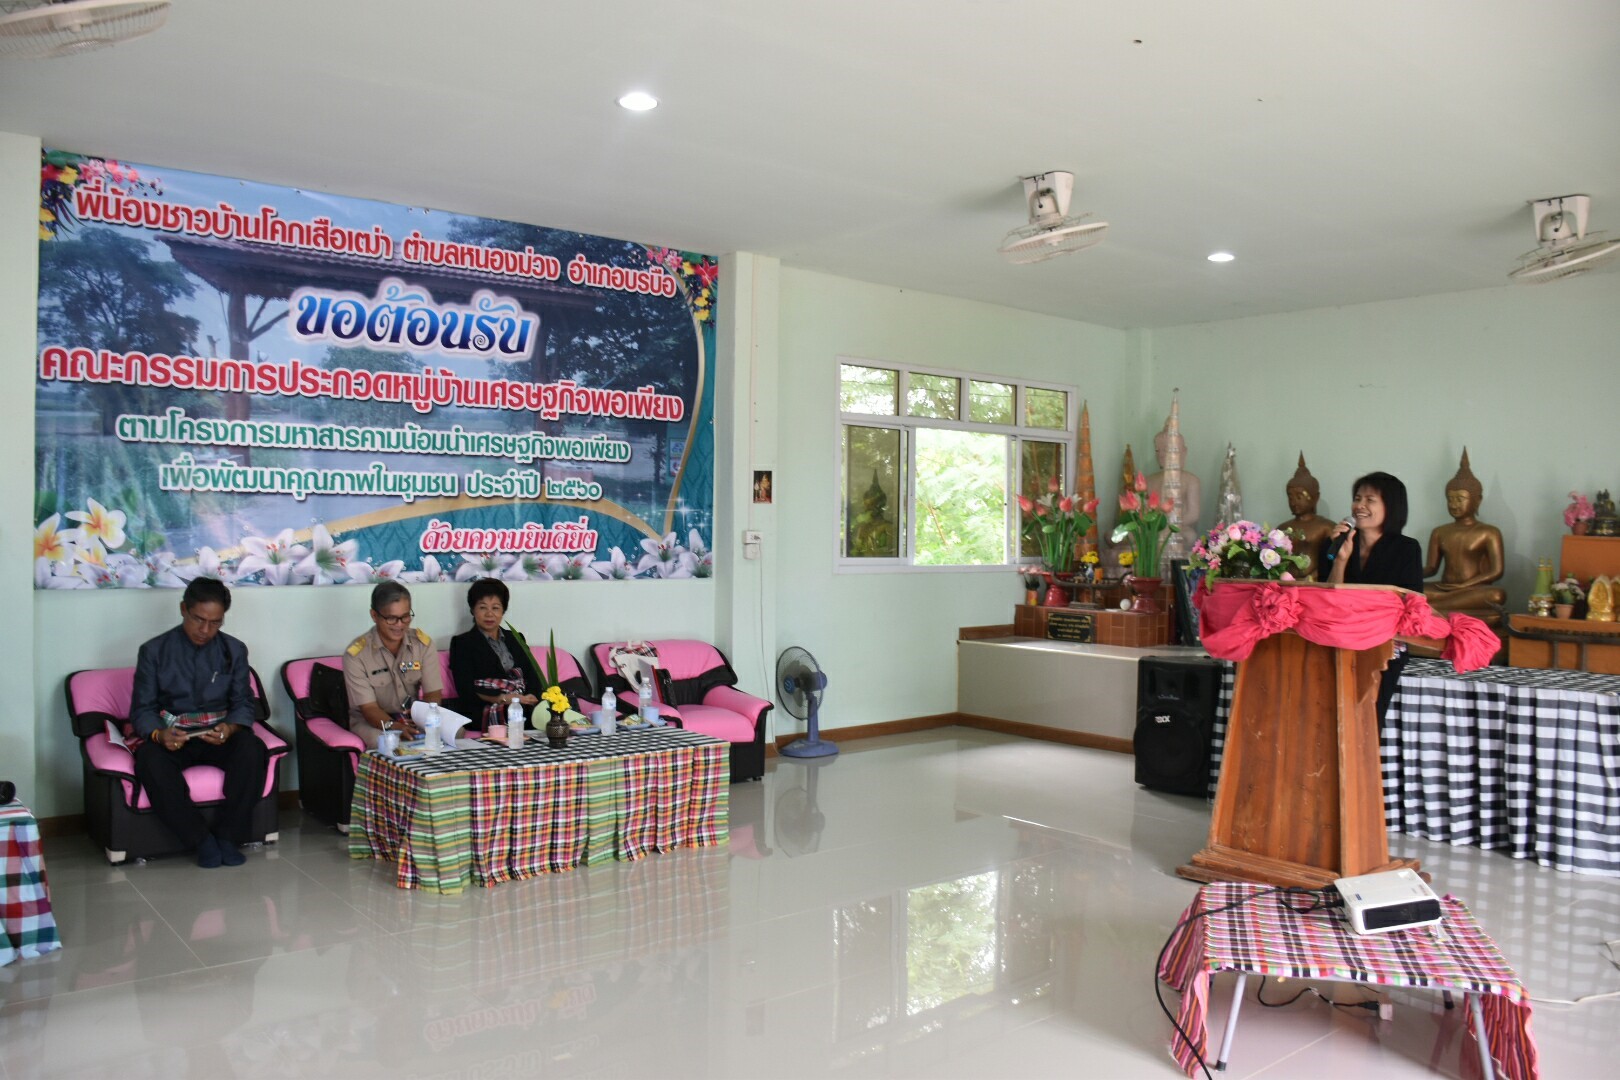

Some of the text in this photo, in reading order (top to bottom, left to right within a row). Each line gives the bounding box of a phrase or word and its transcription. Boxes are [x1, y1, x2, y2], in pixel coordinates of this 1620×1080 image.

[404, 232, 559, 280] ตำบลหนองม่วง
[569, 255, 675, 296] อำเภอบรบือ
[296, 285, 532, 354] ขอต้อนรับ
[42, 347, 683, 420] คณะกรรมการประกวดหมู่บ้านเศรษฐกิจพอเพียง
[118, 410, 630, 461] ตามโครงการมหาสารคามน้อมนำเศรษฐกิจพอเพียง
[161, 455, 601, 500] เพื่อพัฒนาคุณภาพในชุมชน ประจำปี ๒๕๖๐
[422, 518, 597, 550] ด้วยความยินดียิ่ง
